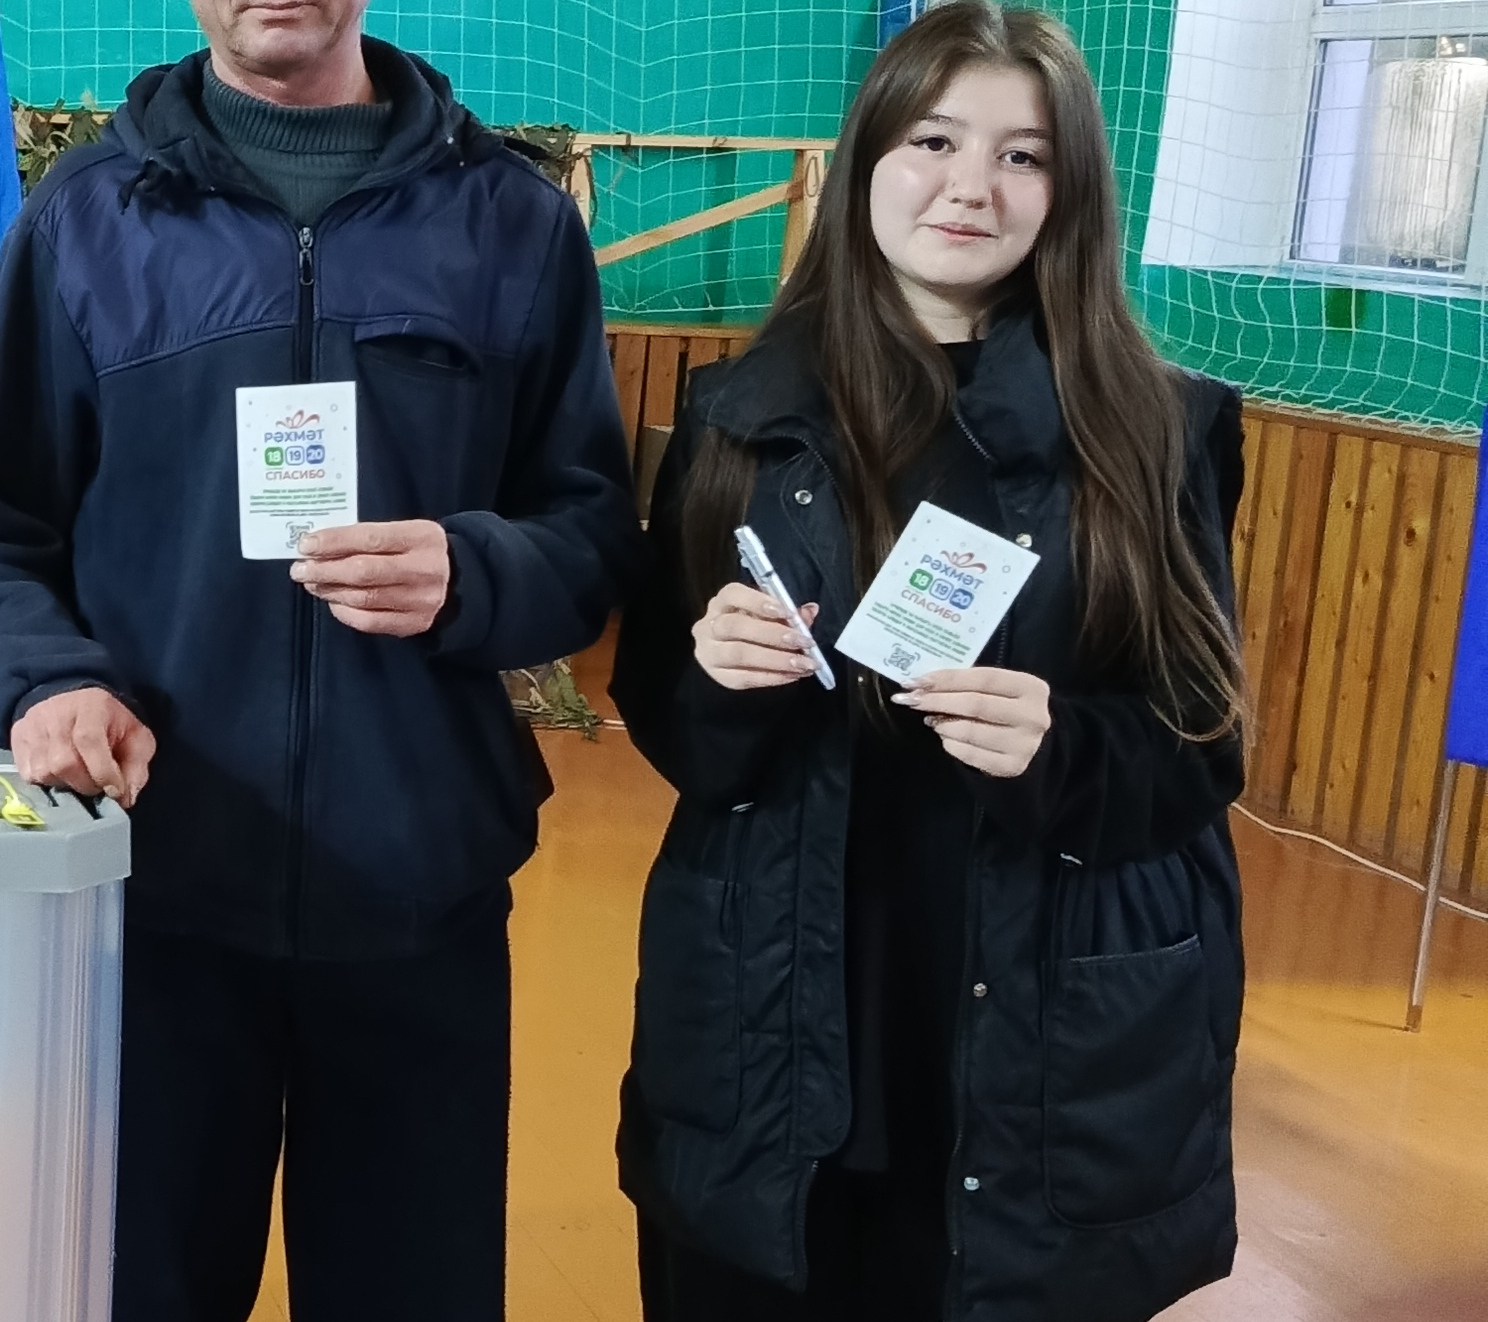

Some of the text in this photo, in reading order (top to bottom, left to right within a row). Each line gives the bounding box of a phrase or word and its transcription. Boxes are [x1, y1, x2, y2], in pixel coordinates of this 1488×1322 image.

[264, 428, 325, 443] РӘХМӘТ
[267, 448, 322, 463] 18 19 20
[265, 468, 326, 481] СПАСИБО
[920, 554, 985, 590] РӘХМӘТ
[913, 572, 970, 606] 18 19 20
[900, 588, 962, 623] СПАСИБО
